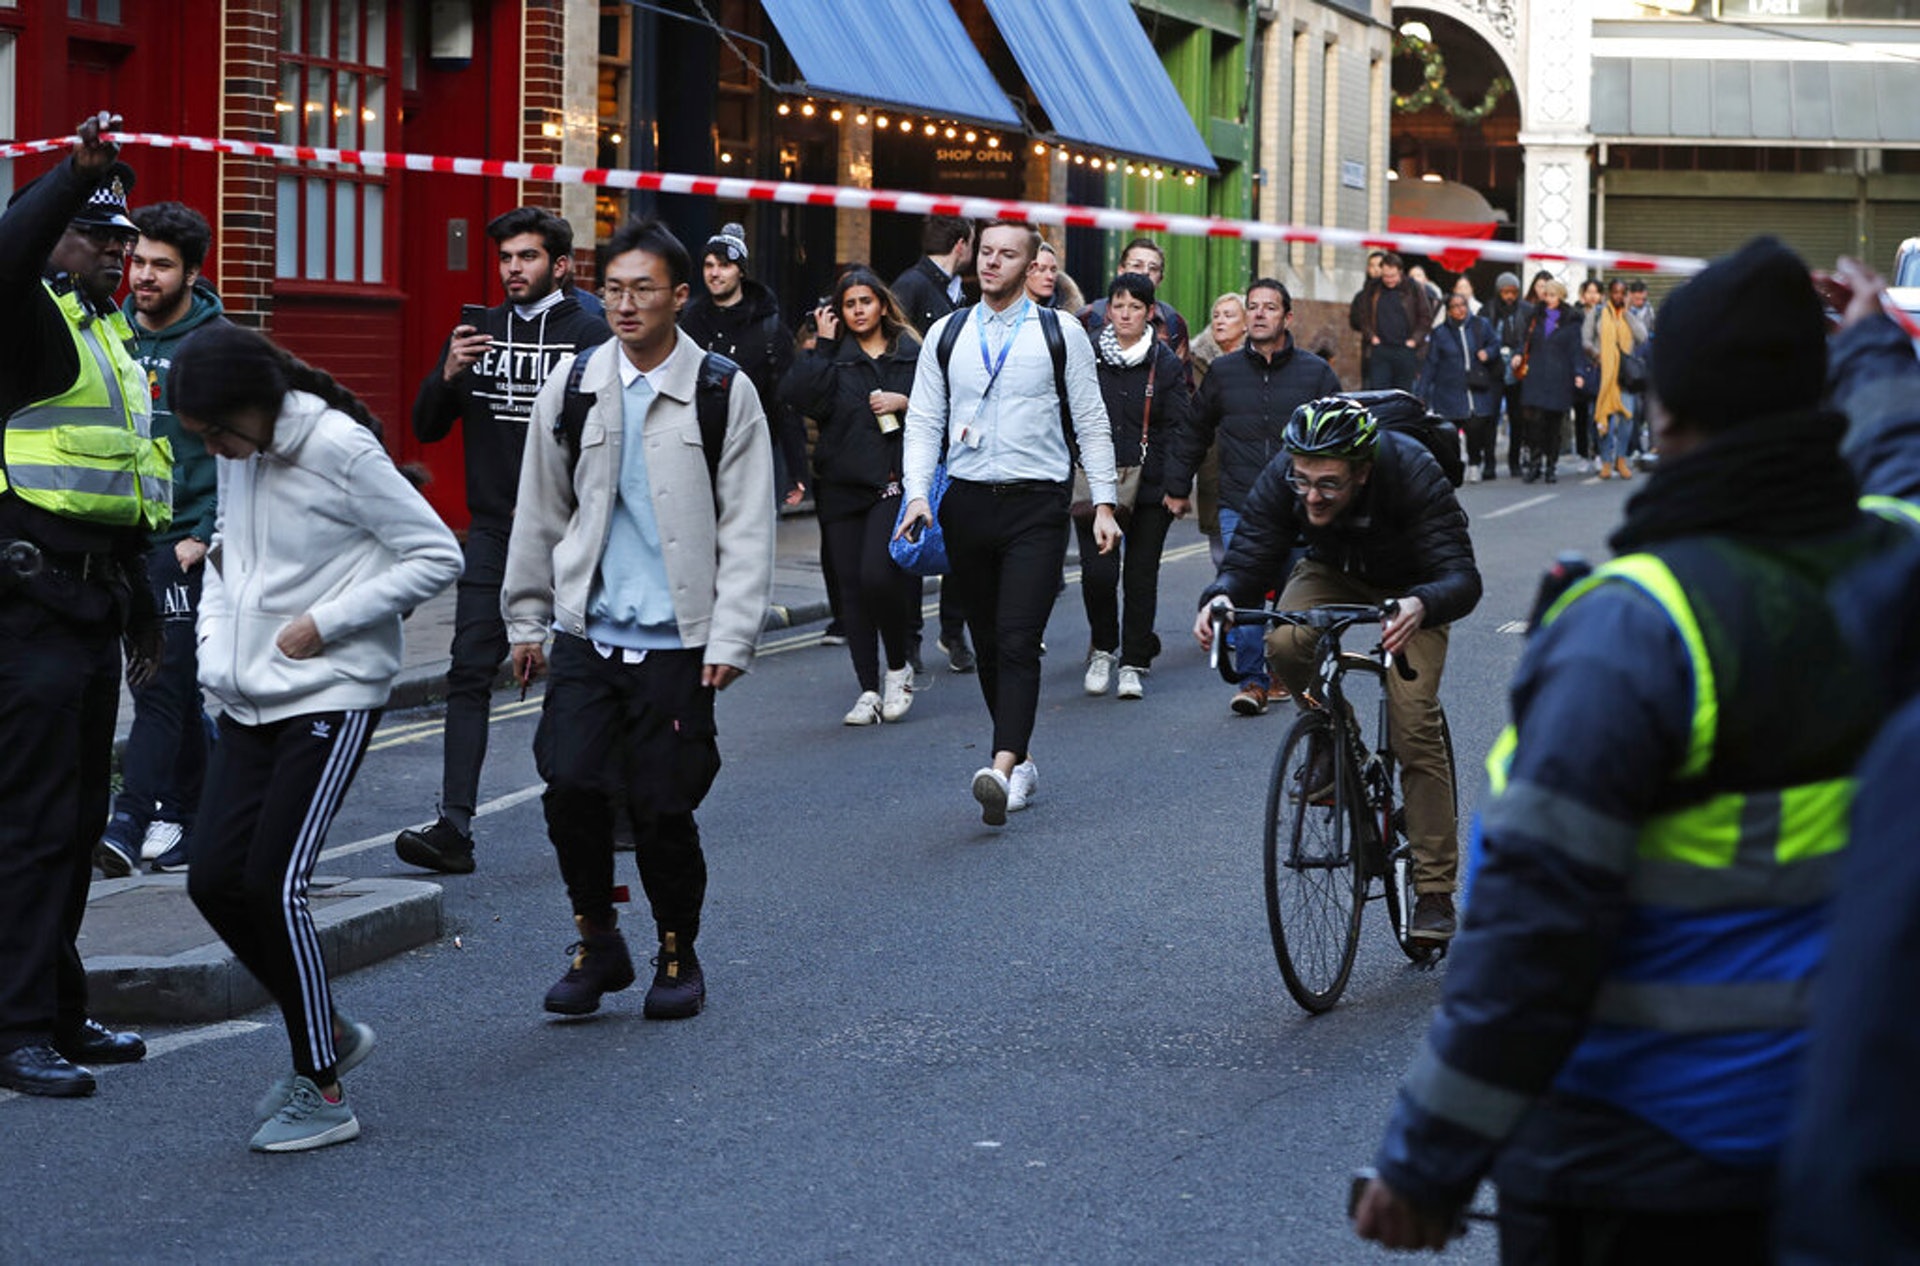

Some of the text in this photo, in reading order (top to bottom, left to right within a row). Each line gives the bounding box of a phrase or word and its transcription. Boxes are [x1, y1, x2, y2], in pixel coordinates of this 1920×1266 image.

[936, 149, 1013, 162] SHOP OPEN
[472, 349, 575, 380] SEATTL
